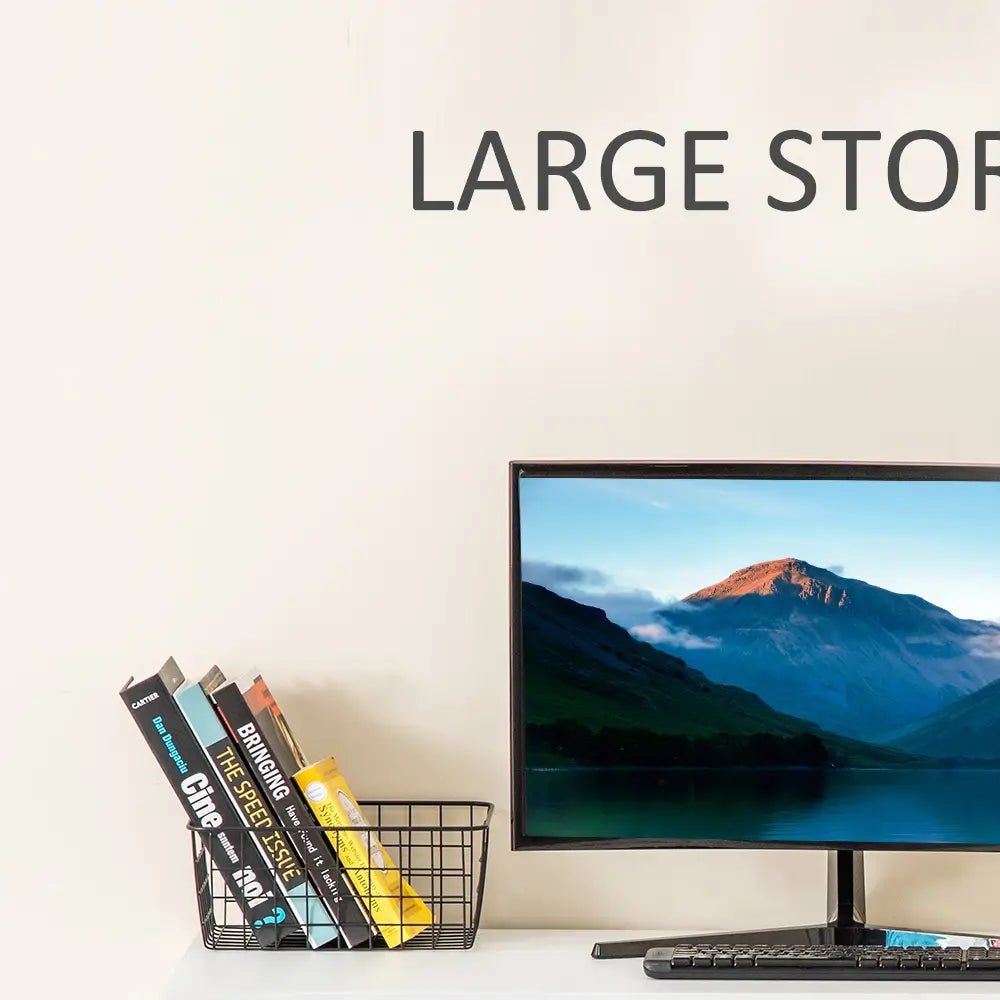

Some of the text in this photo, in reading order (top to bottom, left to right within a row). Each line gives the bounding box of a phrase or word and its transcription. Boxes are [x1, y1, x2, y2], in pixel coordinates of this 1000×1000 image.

[131, 691, 160, 710] CARTIER
[152, 716, 187, 774] Dan Dungaciu
[237, 722, 290, 801] BRINGING
[181, 773, 222, 830] Cine
[232, 865, 274, 908] noi
[253, 906, 287, 929] ?
[217, 746, 300, 882] THE SPEED ISSUE
[286, 805, 300, 826] Have
[314, 856, 323, 866] it
[315, 804, 351, 854] Synoyms
[351, 867, 383, 913] Antonms
